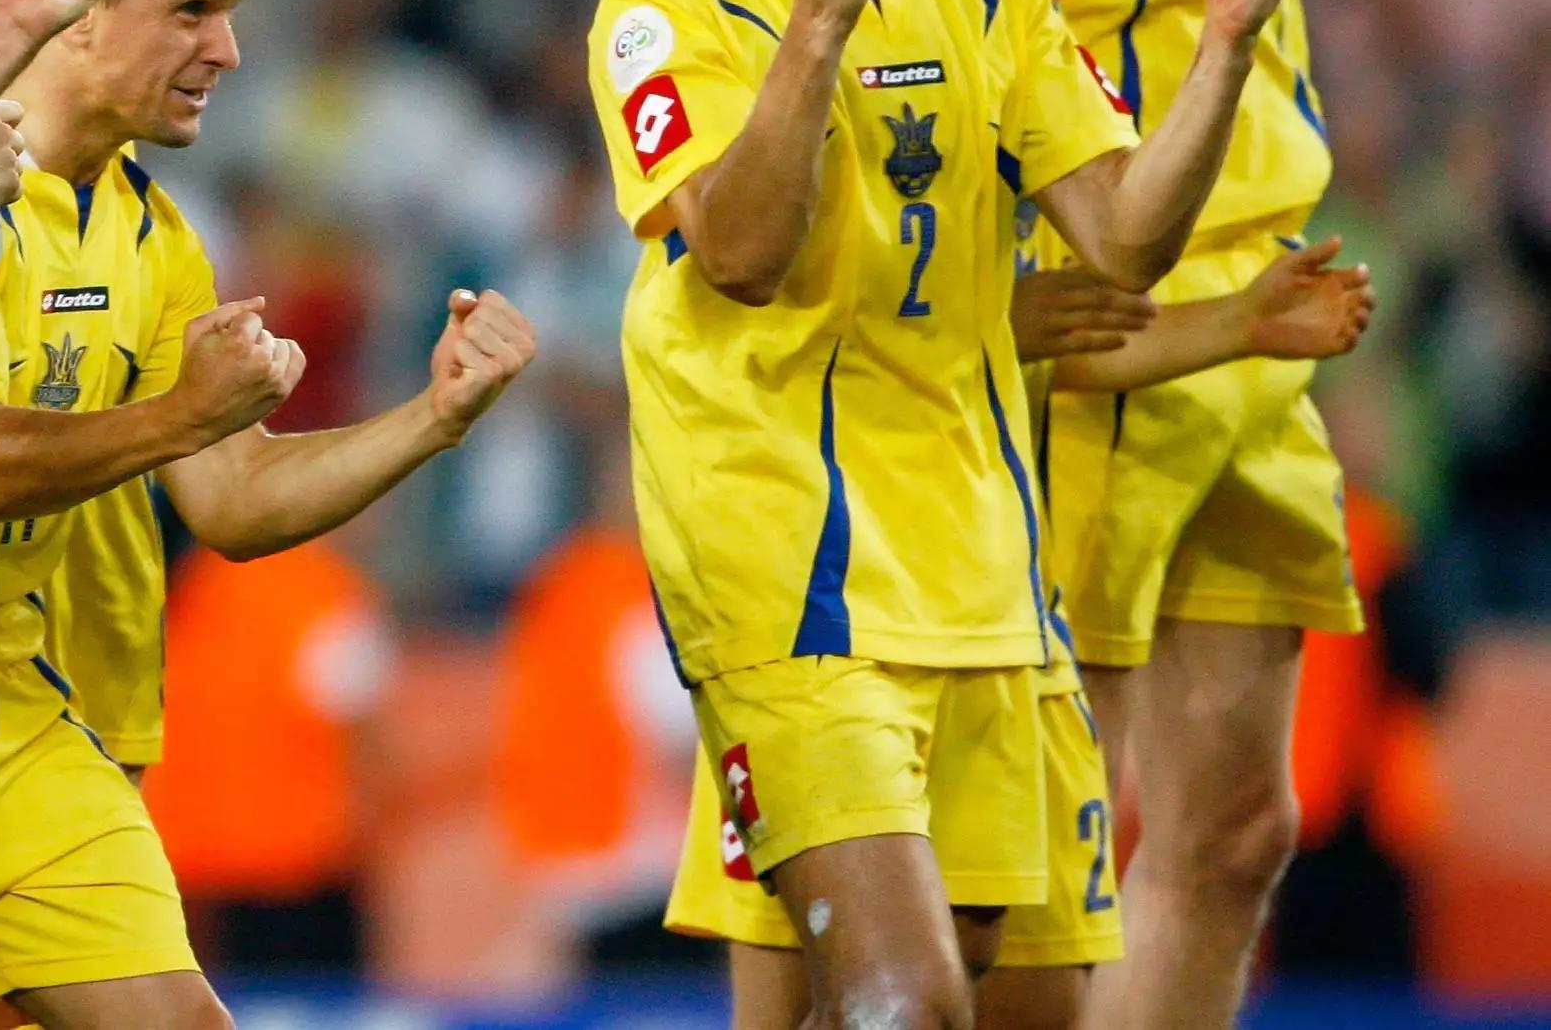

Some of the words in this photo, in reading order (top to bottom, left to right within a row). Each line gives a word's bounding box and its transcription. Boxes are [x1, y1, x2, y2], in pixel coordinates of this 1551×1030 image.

[881, 66, 941, 84] lotto
[898, 201, 937, 317] 2
[54, 292, 107, 308] lotto
